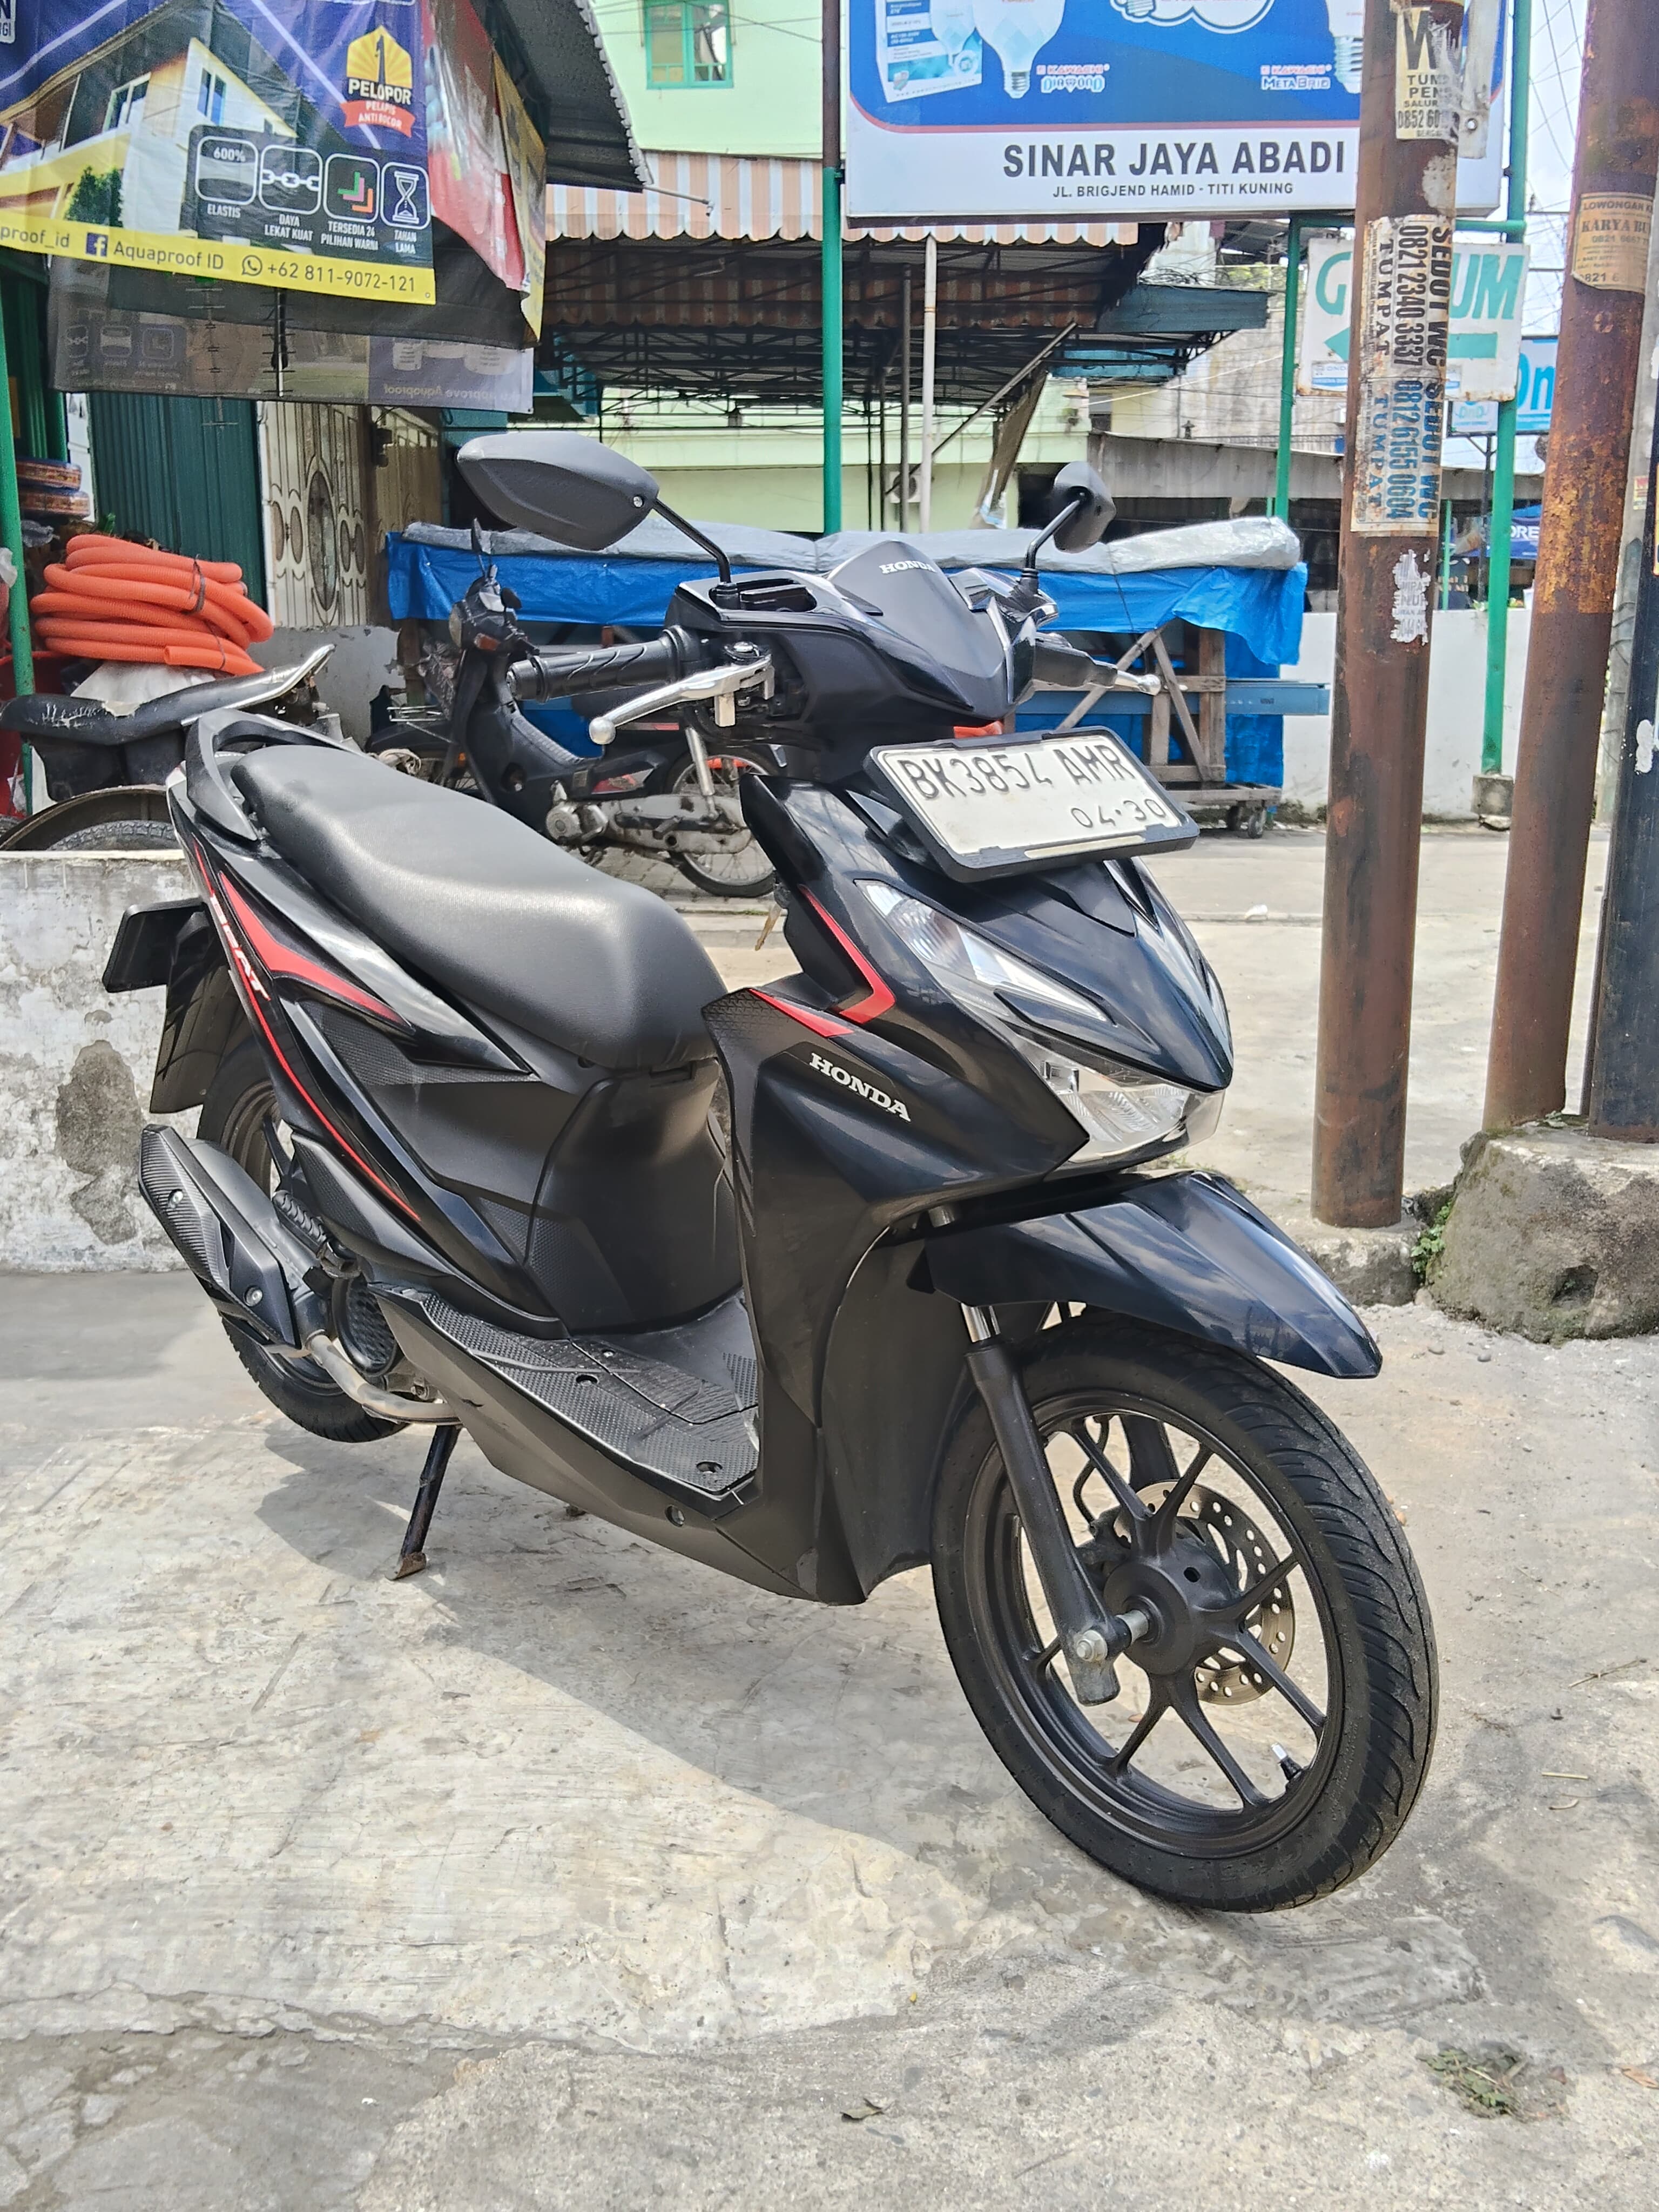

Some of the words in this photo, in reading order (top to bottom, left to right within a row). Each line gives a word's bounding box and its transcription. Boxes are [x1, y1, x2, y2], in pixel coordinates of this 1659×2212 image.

[348, 78, 412, 105] PELOPOR
[213, 146, 246, 162] 600%
[1003, 144, 1116, 177] SINAR
[1129, 143, 1219, 176] JAYA
[1232, 141, 1344, 174] ABADI
[1053, 186, 1073, 198] JL.
[1077, 185, 1145, 197] BRIGJEND
[1151, 184, 1195, 195] HAMID
[1208, 184, 1233, 194] TITI
[1239, 183, 1293, 194] KUNING
[207, 204, 241, 218] ELASTIS
[279, 214, 300, 227] DAYA
[265, 225, 290, 238] LEKAT
[292, 229, 313, 241] KUAT
[321, 234, 352, 247] PILIHAN
[328, 220, 365, 237] TERSEDIA
[366, 226, 375, 238] 24
[394, 230, 417, 242] TAHAN
[1582, 219, 1630, 233] KARYA
[113, 241, 202, 268] Aquaproof
[208, 254, 224, 270] ID
[395, 241, 416, 254] LAMA
[1398, 225, 1429, 269] 0821
[267, 262, 298, 279] +62
[305, 265, 415, 292] 811-9072-121
[1429, 226, 1452, 315] SEDOT
[1580, 272, 1607, 282] 821
[1377, 239, 1393, 355] TUMPAT
[1395, 272, 1427, 319] 2340
[1393, 323, 1425, 367] 3337
[1426, 321, 1448, 367] WC
[1392, 380, 1423, 423] 0812
[1368, 393, 1388, 508] TUMPAT
[1388, 426, 1420, 470] 6155
[1386, 473, 1417, 520] 0604
[879, 559, 937, 575] HONDA
[1053, 743, 1135, 786] AMR
[809, 1052, 912, 1122] HONDA
